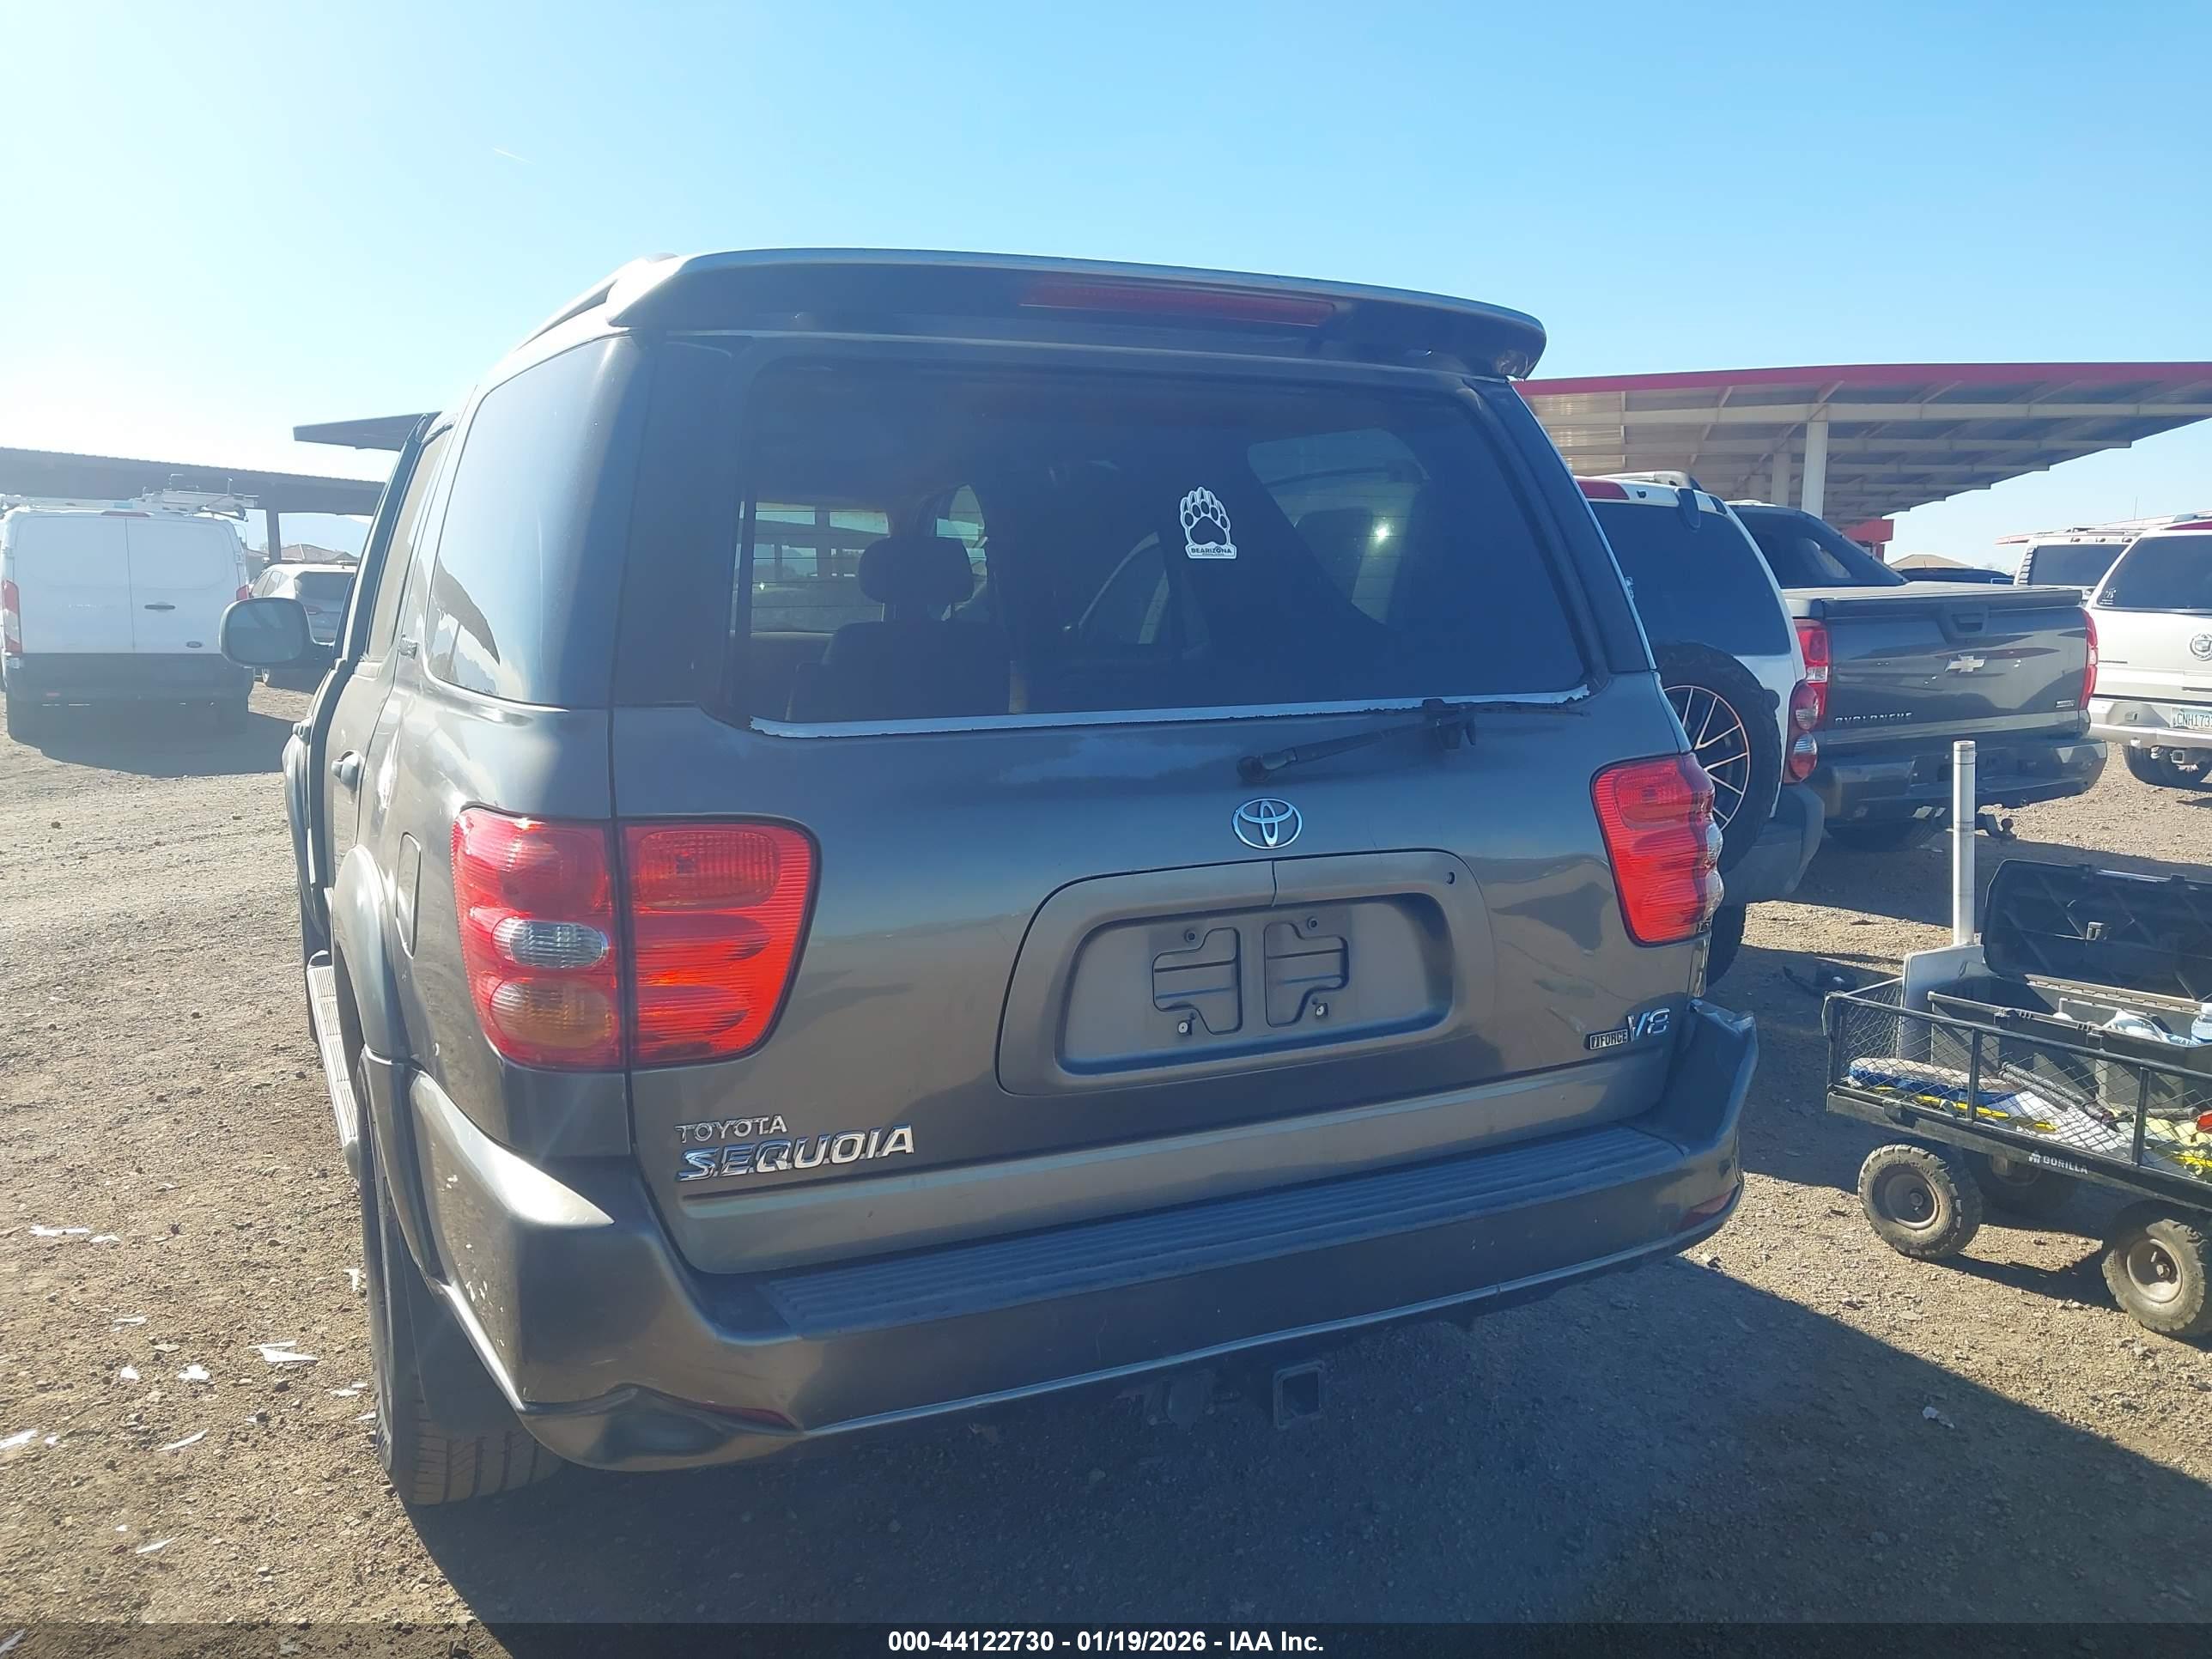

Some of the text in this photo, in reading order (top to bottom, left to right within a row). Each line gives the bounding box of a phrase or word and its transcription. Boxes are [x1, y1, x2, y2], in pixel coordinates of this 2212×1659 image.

[1190, 545, 1232, 554] BEARIZONA
[2177, 713, 2212, 728] CNH173
[1627, 1008, 1671, 1042] V8
[675, 1115, 787, 1144] TOYOTA
[676, 1124, 915, 1182] SEQUOIA
[2043, 1154, 2089, 1176] GORILLA
